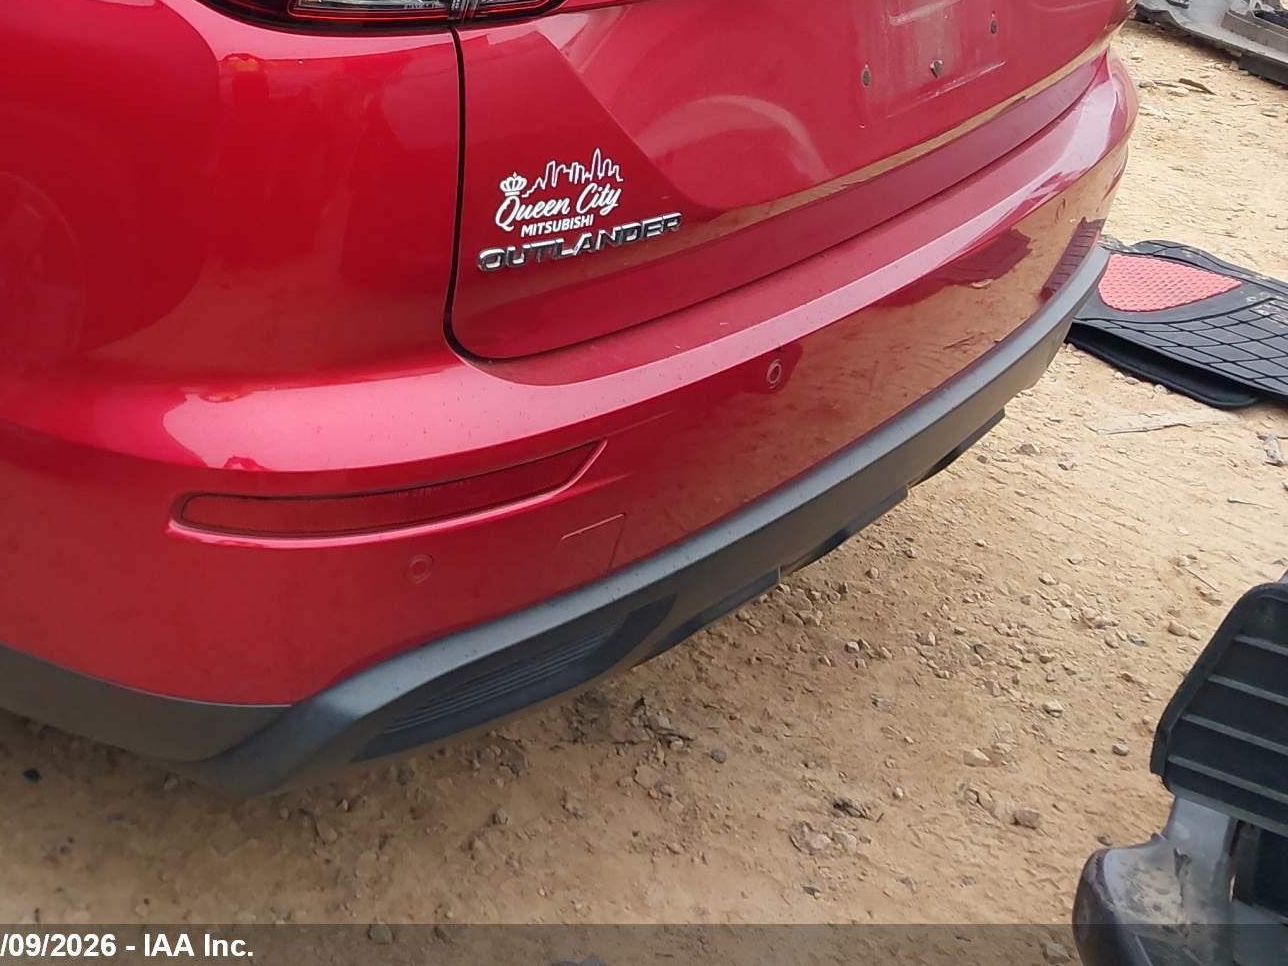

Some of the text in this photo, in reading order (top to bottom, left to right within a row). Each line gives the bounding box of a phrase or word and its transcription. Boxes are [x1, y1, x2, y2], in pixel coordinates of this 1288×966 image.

[495, 183, 621, 231] Queen City
[520, 214, 593, 237] MITSUBISHI
[476, 212, 682, 272] OUTLANDER
